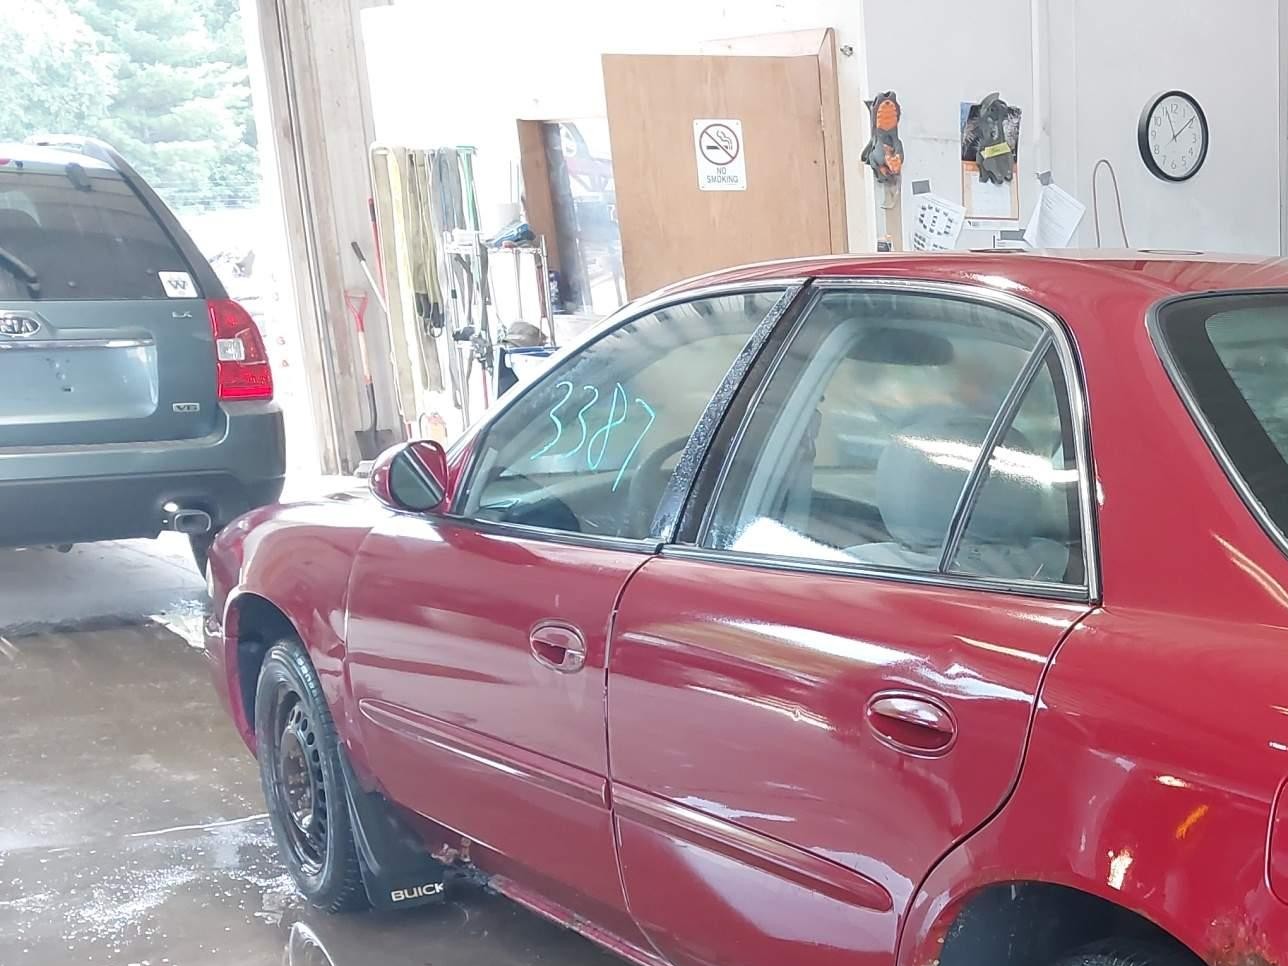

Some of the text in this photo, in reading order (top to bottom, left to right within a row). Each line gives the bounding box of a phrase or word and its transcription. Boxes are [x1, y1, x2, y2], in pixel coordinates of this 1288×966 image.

[1170, 103, 1179, 115] 12
[1153, 115, 1162, 127] 10
[1151, 129, 1157, 140] 9
[1192, 132, 1197, 144] 3
[1153, 143, 1160, 155] 8
[1188, 146, 1194, 157] 4
[1162, 154, 1168, 166] 7
[1170, 159, 1177, 170] 6
[1181, 155, 1187, 167] 5
[716, 166, 727, 175] NO
[706, 175, 739, 184] SMOKING
[530, 380, 656, 492] 3387
[390, 882, 444, 902] BUICK
